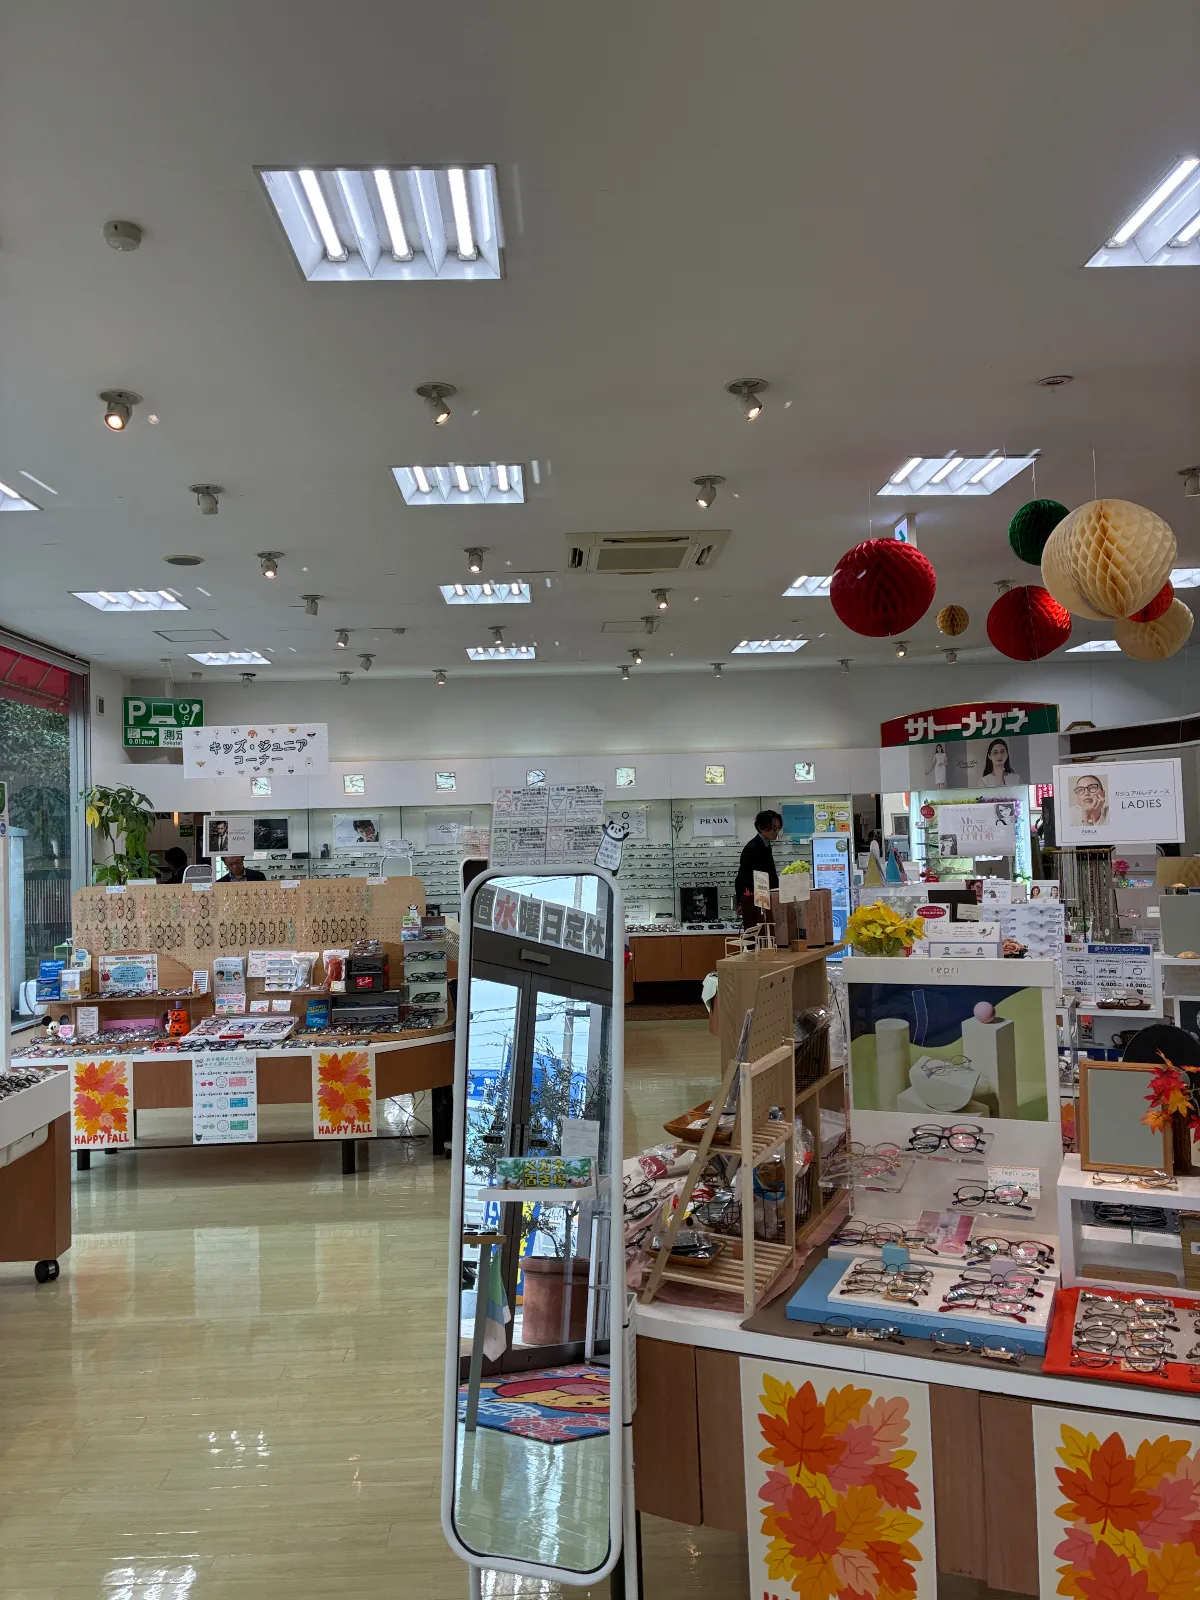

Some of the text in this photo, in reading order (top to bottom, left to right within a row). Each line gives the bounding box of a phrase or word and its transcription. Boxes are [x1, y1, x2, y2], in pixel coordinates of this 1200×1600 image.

[128, 700, 147, 725] P
[904, 707, 1029, 742] サトーメガネ
[209, 738, 308, 755] キッズ・ジュニア
[234, 753, 284, 766] コーナー
[1114, 788, 1171, 797] カジュアルレディース
[1121, 799, 1162, 810] LADIES
[930, 966, 959, 974] repri
[318, 1123, 373, 1135] HAPPY FALL
[74, 1132, 130, 1144] HAPPY FALL
[523, 1159, 566, 1173] メガネ
[523, 1173, 567, 1188] 置き場
